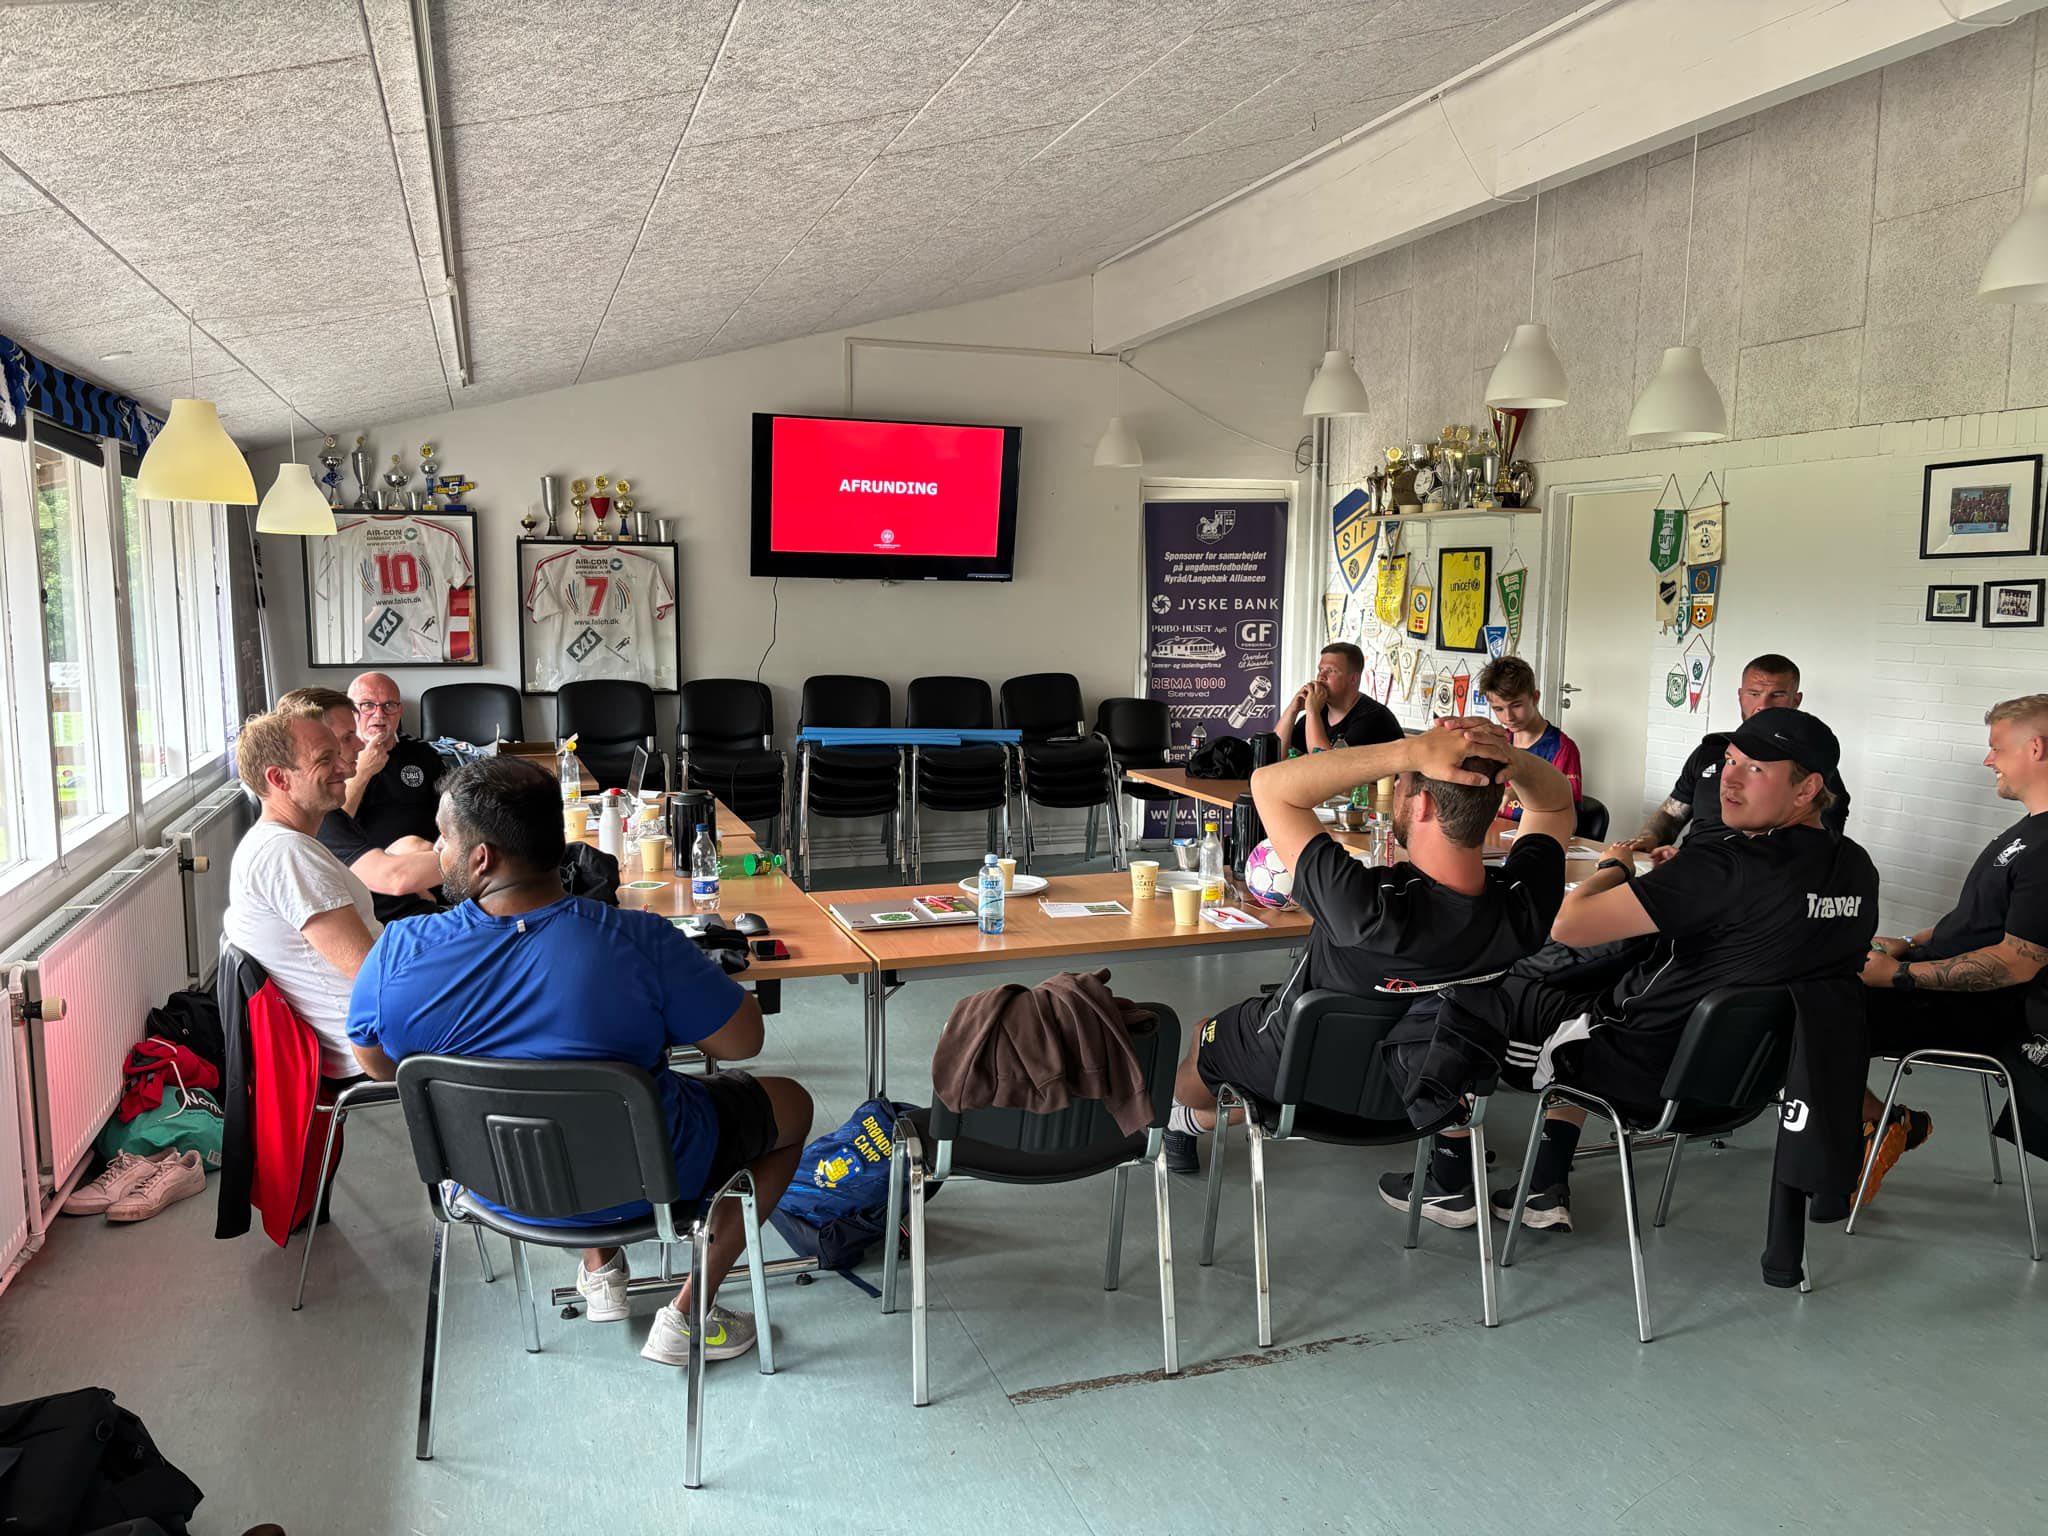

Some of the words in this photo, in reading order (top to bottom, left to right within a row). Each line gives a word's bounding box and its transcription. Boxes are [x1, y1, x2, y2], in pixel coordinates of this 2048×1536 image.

[839, 478, 938, 495] AFRUNDING
[366, 529, 402, 537] AIR-CON
[1342, 521, 1369, 551] SIF
[1164, 551, 1204, 562] Sponsorer
[1205, 551, 1217, 560] for
[1218, 551, 1267, 561] samarbejdet
[373, 552, 419, 595] 10
[1173, 562, 1183, 573] på
[1185, 562, 1258, 573] ungdomsfodbolden
[1164, 574, 1228, 584] Nyråd/Langebæk
[1229, 574, 1266, 583] Alliancen
[584, 577, 608, 616] 7
[1178, 598, 1228, 610] JYSKE
[1234, 598, 1279, 610] BANK
[374, 610, 399, 644] SAS
[1151, 624, 1212, 633] PRIBO-HUSET
[1241, 623, 1272, 642] GF
[572, 629, 598, 661] SAS
[1151, 677, 1192, 689] REMA
[1195, 677, 1226, 689] 1000
[854, 1134, 880, 1162] CAMP
